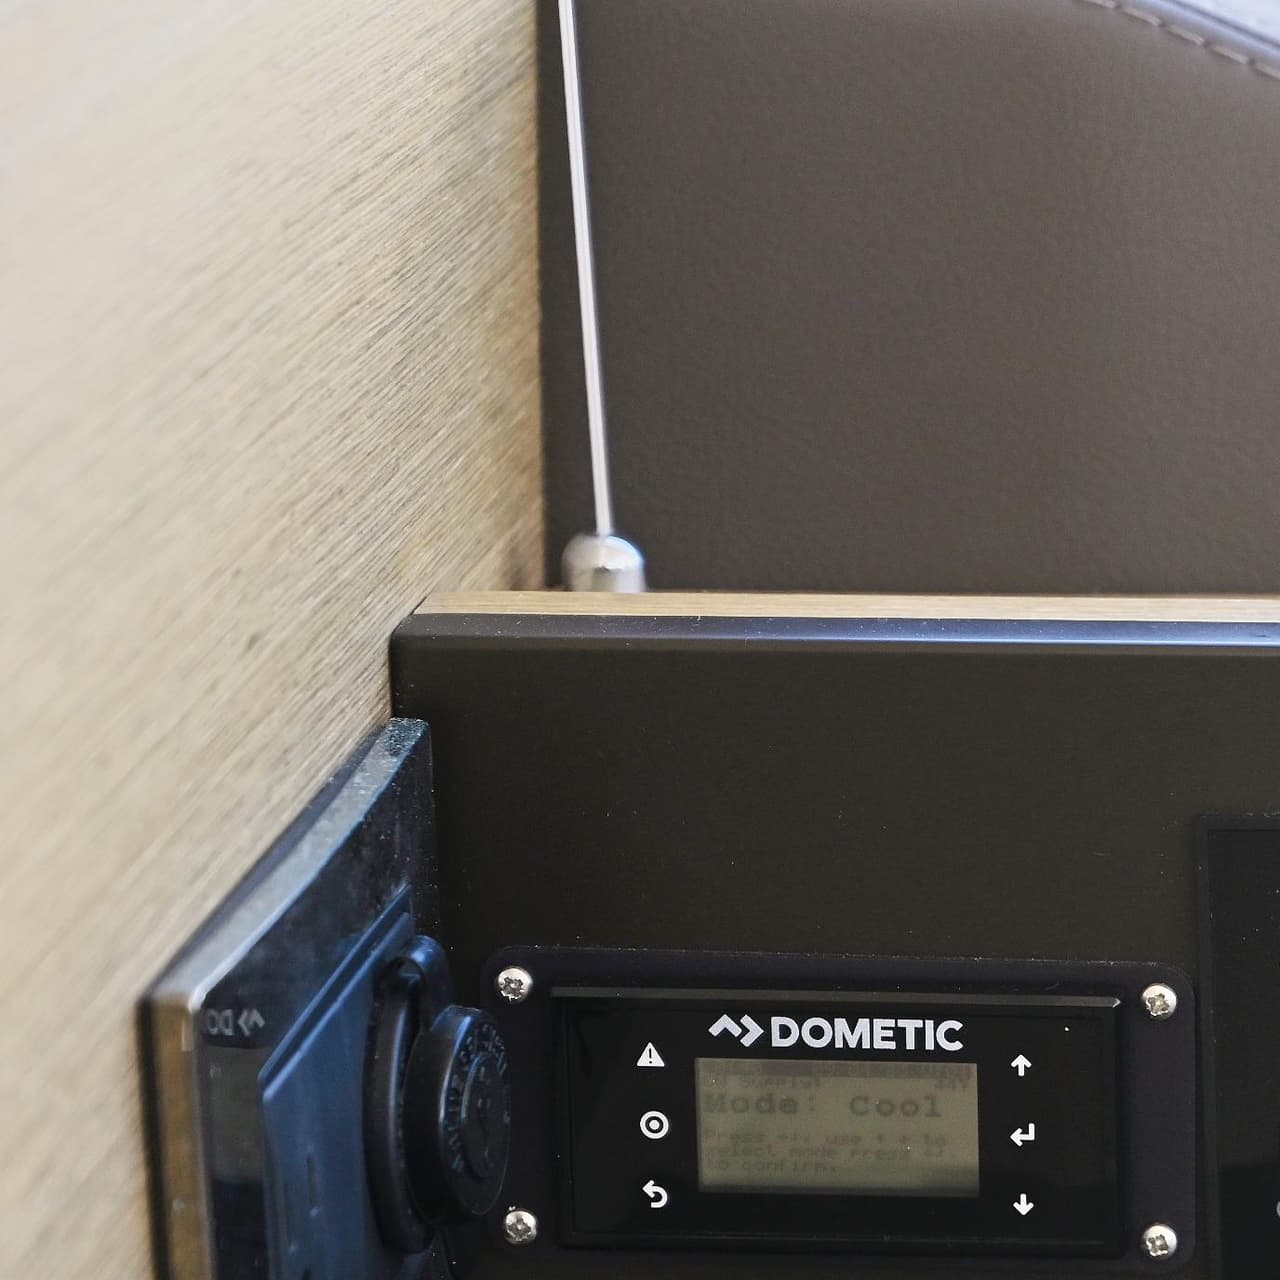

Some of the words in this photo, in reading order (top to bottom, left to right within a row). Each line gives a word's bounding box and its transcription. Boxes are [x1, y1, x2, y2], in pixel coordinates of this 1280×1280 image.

[770, 1016, 964, 1052] DOMETIC
[705, 1092, 817, 1115] Mode:
[850, 1094, 943, 1118] Cool
